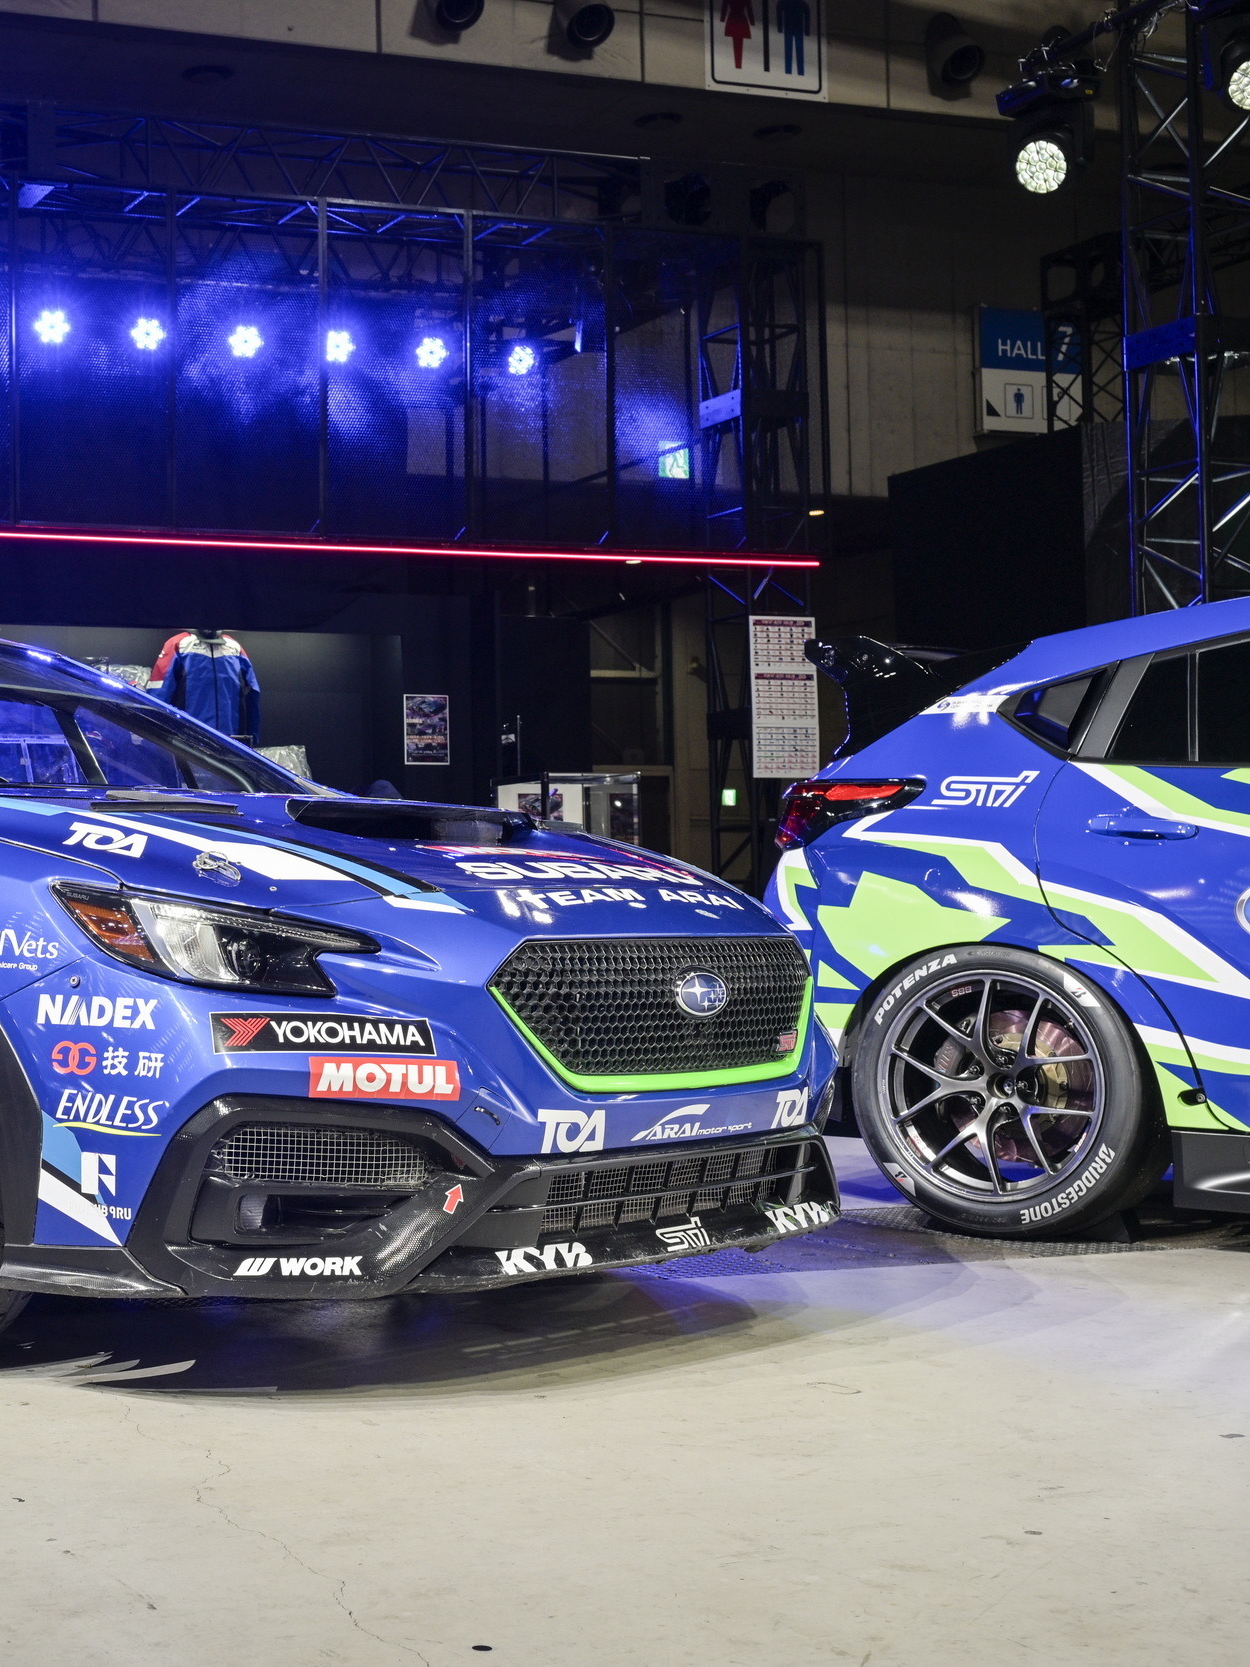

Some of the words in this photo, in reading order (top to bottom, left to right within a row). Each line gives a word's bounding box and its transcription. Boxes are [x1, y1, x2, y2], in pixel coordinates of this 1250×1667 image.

[997, 339, 1046, 360] HALL
[1057, 326, 1073, 361] 7
[62, 821, 148, 858] TOA
[455, 862, 703, 886] SUBARU
[516, 888, 646, 910] TEAM
[658, 889, 744, 911] ARAI
[874, 953, 958, 1026] POTENZA
[36, 993, 158, 1030] NADEX
[269, 1020, 425, 1046] YOKOHAMA
[102, 1046, 165, 1079] 技研
[316, 1062, 454, 1095] MOTUL
[56, 1089, 164, 1130] ENDLESS
[538, 1109, 605, 1154] TOA
[646, 1122, 700, 1140] ARAI
[1020, 1142, 1116, 1225] BRIDGESTONE
[279, 1255, 363, 1277] WORK
[495, 1242, 593, 1276] KYB
